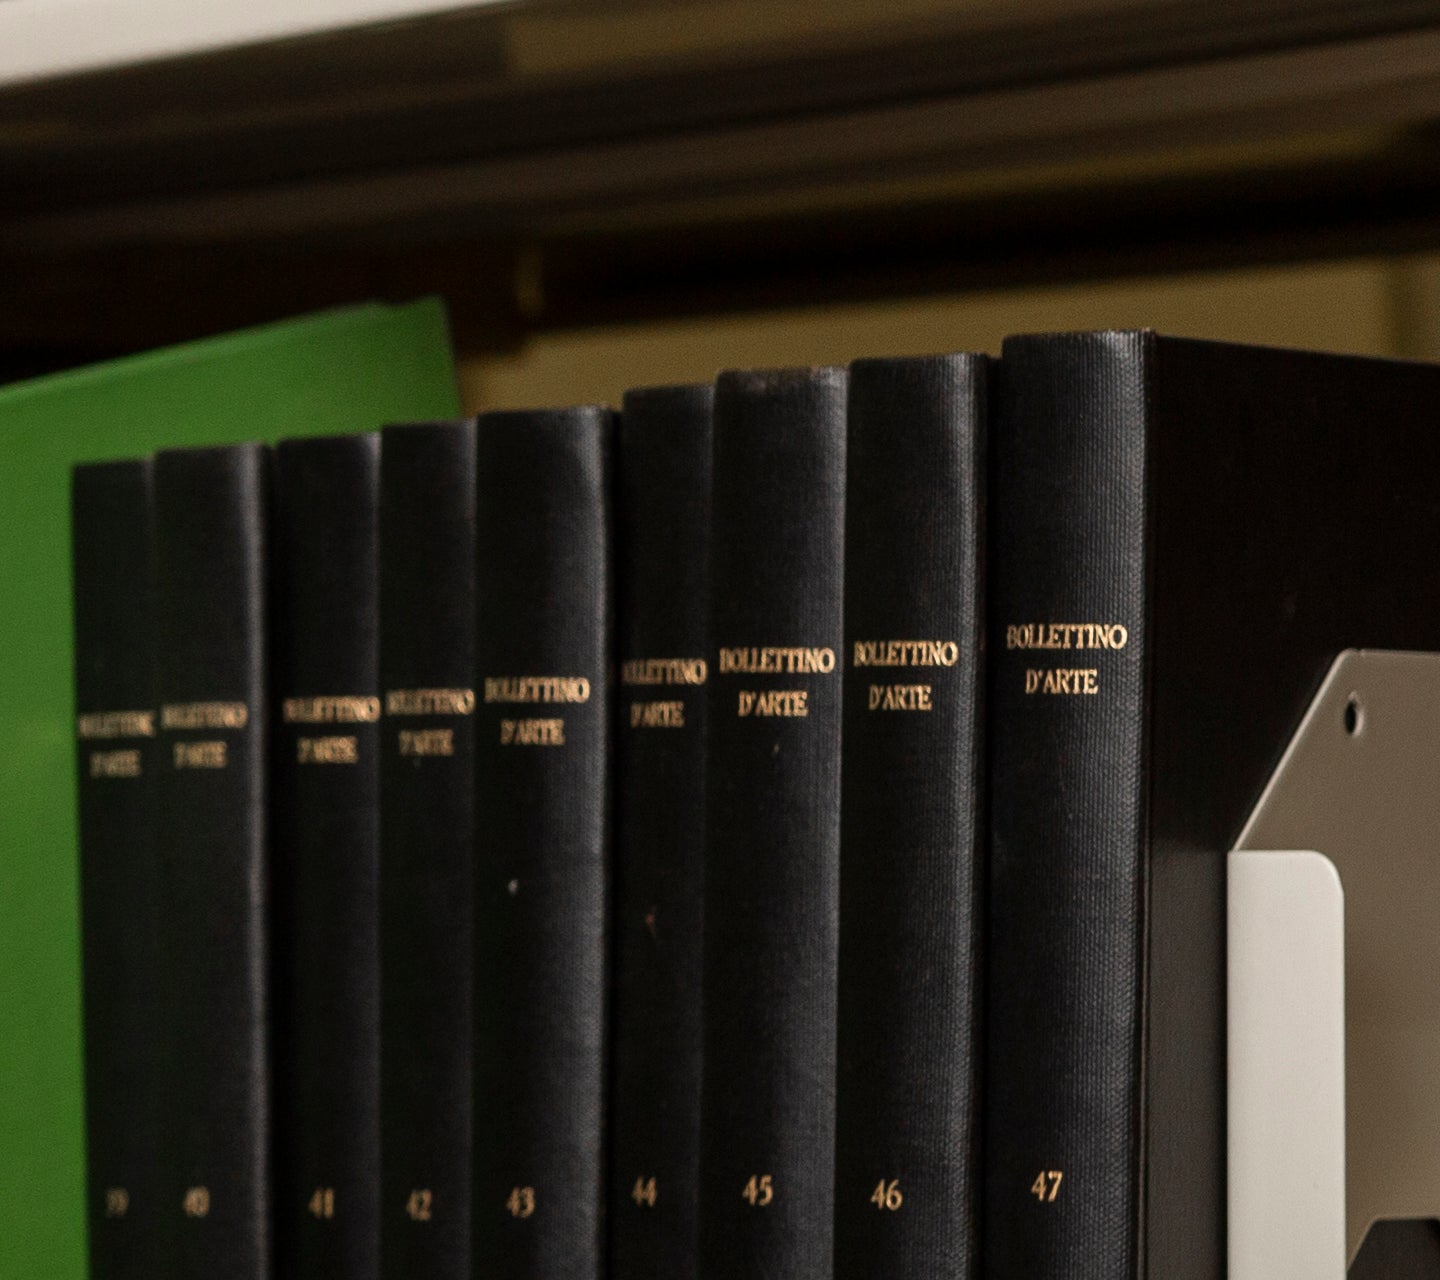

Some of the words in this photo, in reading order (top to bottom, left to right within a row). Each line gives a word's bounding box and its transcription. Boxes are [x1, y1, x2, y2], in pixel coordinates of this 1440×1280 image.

[1006, 623, 1128, 651] BOLLETTINO
[718, 646, 836, 674] BOLLETTINO
[852, 640, 959, 668] BOLLETTINO
[868, 683, 932, 711] D'ARTE
[1024, 668, 1099, 696] D'ARTE
[738, 690, 809, 718] D'ARTE
[631, 1175, 659, 1208] 44
[741, 1173, 774, 1207] 45
[870, 1177, 904, 1212] 46
[1029, 1169, 1064, 1203] 47
[308, 1186, 335, 1219] 41
[506, 1185, 536, 1219] 43
